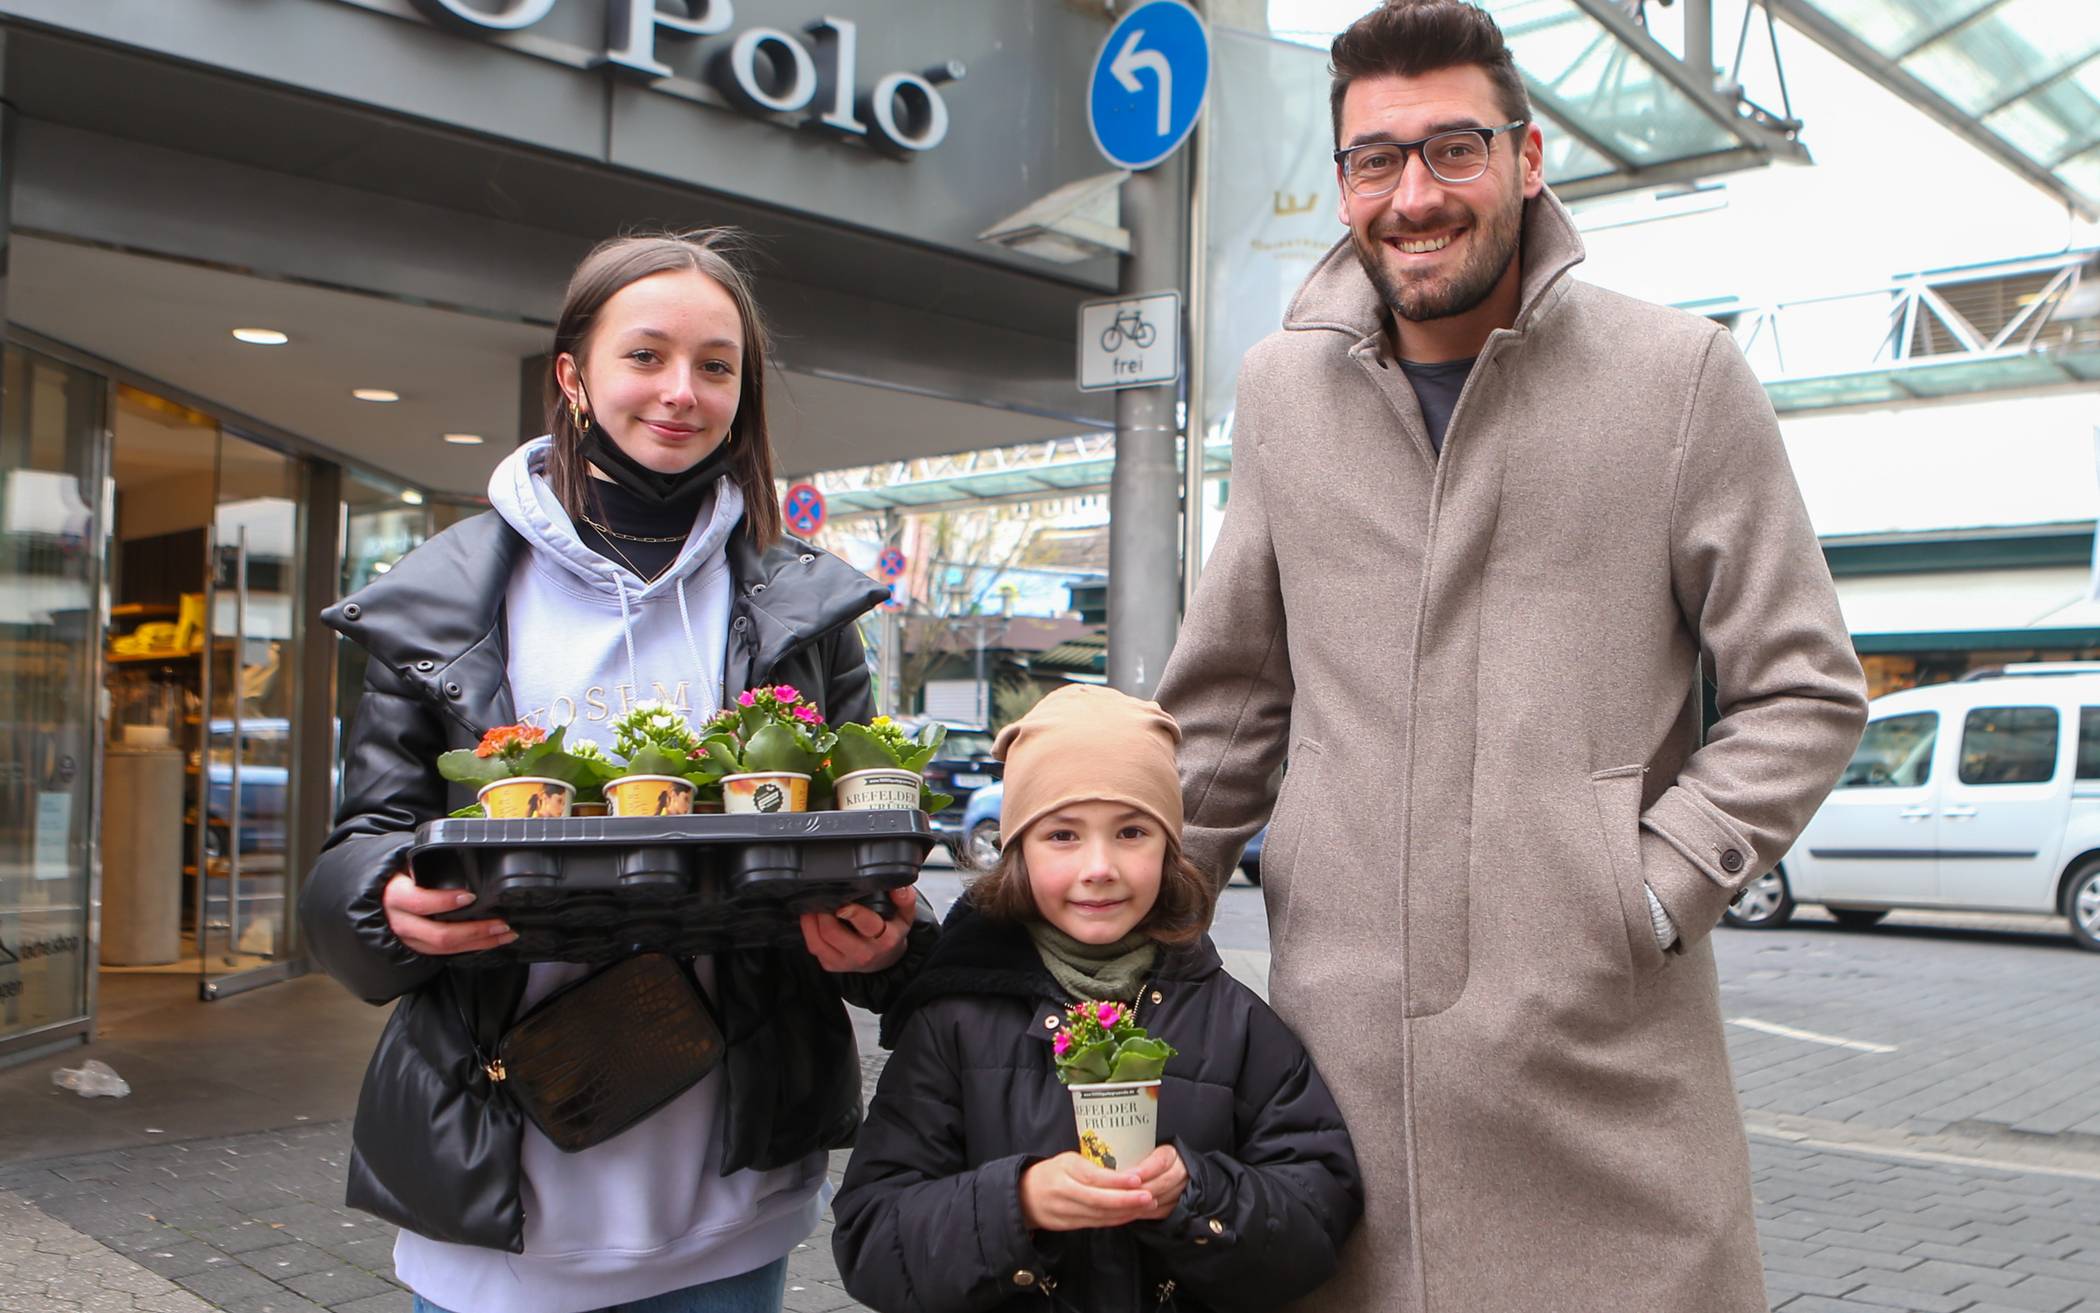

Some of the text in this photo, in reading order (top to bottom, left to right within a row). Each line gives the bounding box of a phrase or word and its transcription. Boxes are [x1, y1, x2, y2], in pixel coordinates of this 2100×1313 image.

[607, 0, 948, 152] Polo
[1113, 354, 1143, 375] frei
[846, 790, 917, 806] KREFELDER
[1085, 1113, 1150, 1129] FRÜHLING
